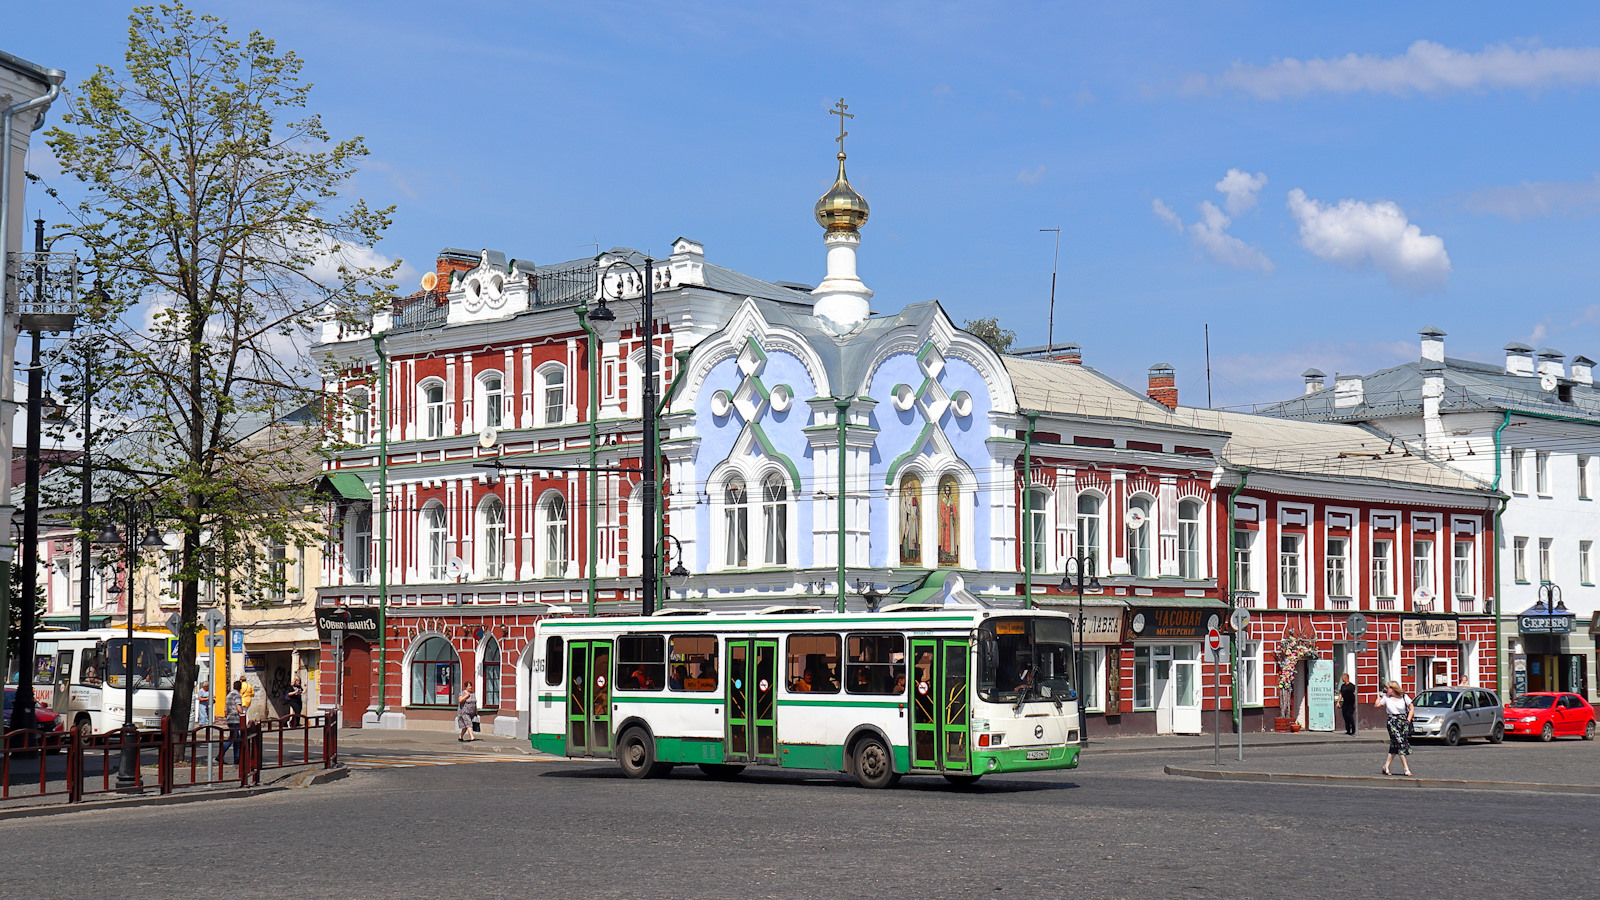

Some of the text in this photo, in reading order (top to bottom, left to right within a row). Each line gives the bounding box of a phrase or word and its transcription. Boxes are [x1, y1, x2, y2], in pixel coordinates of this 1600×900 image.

[1155, 610, 1202, 626] ЧАСОВАЯ
[1522, 617, 1568, 628] СЕРЕБРО
[1156, 628, 1196, 636] МАСТЕРСКАЯ
